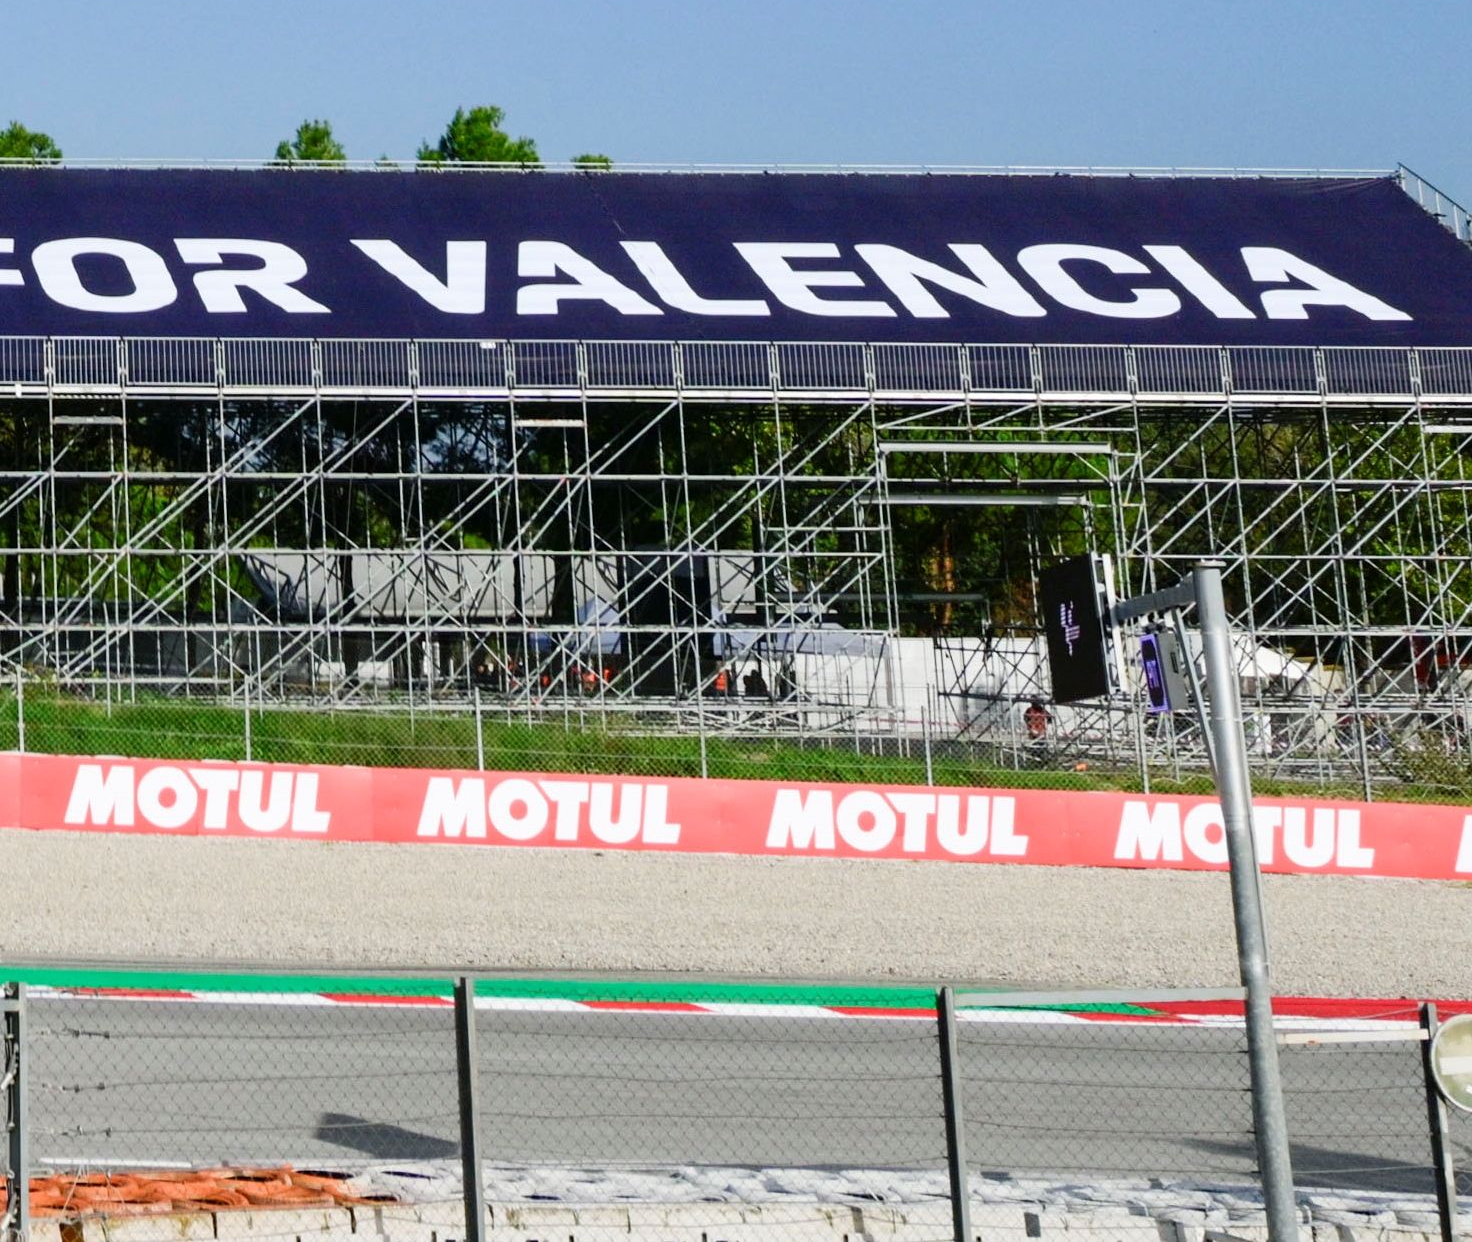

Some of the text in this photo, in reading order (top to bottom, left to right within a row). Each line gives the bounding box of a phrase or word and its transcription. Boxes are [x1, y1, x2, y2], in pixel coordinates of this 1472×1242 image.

[349, 239, 1414, 321] VALENCIA
[63, 763, 331, 833] MOTUL
[414, 776, 682, 845] MOTUL
[765, 788, 1029, 856] MOTUL
